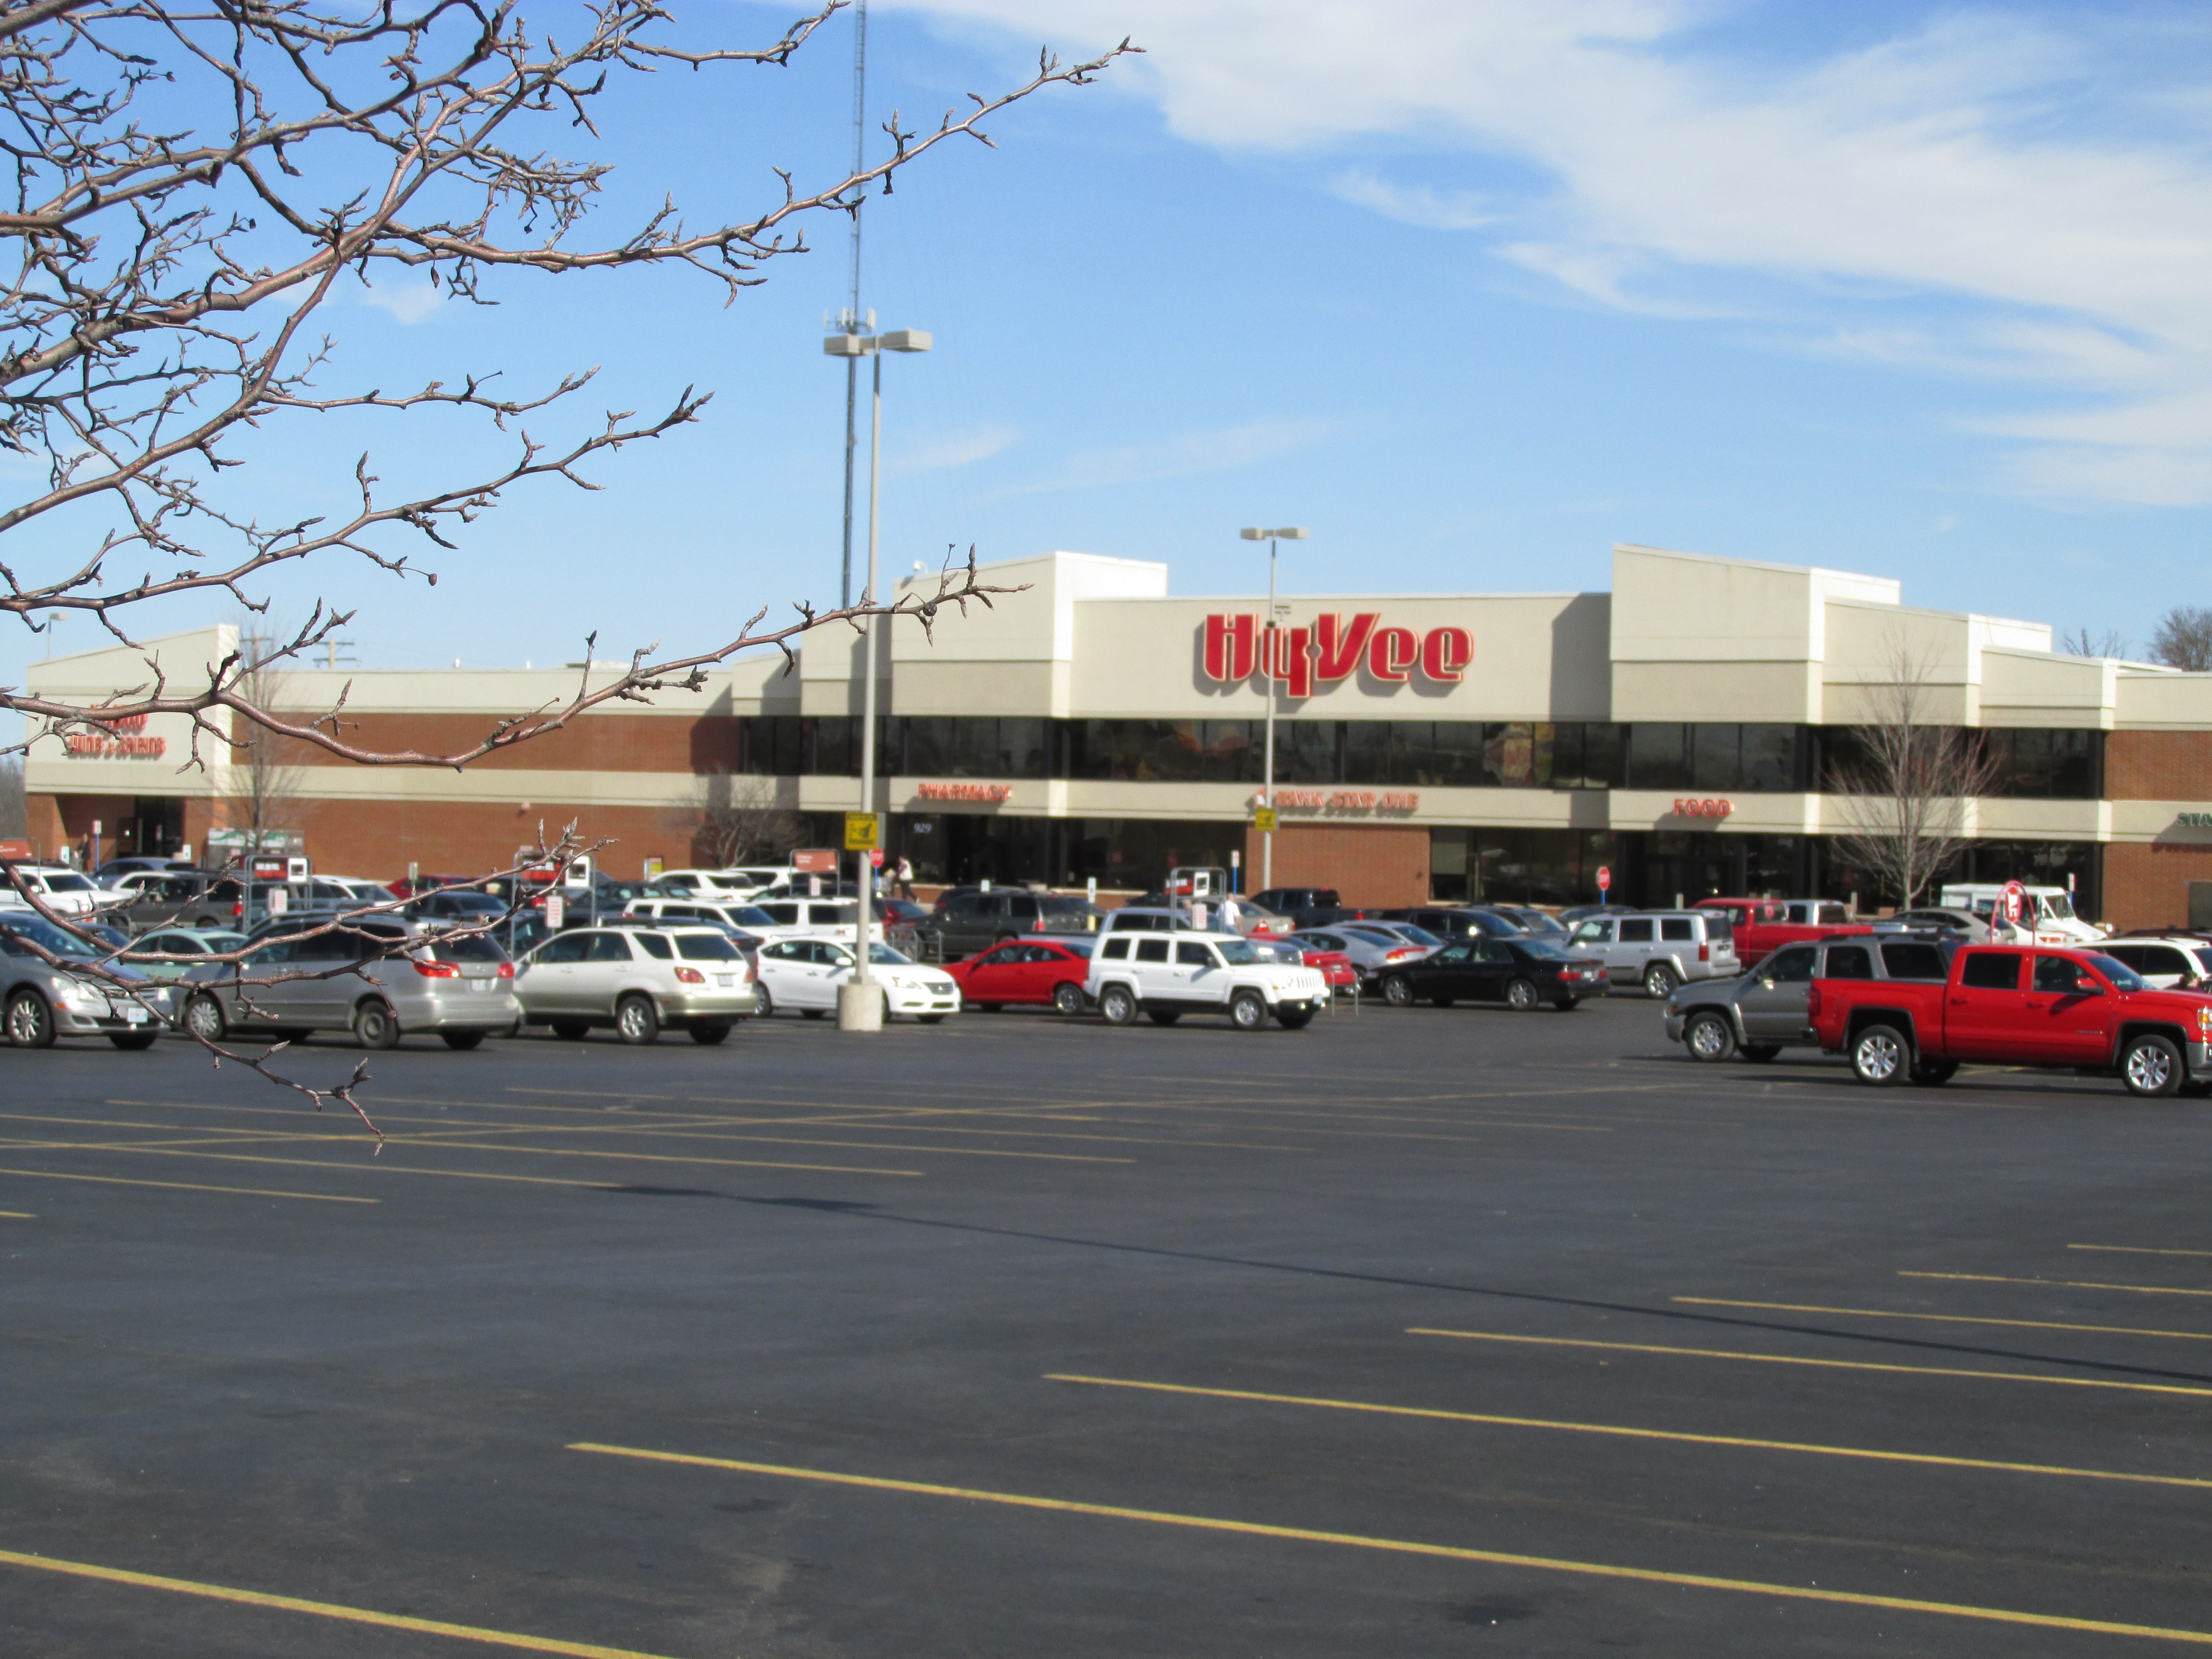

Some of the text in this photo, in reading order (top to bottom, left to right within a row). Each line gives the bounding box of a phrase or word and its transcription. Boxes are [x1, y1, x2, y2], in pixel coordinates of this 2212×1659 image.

[918, 783, 1011, 801] PHARMACY
[1276, 791, 1419, 809] BANK STAR ONE
[1673, 798, 1733, 816] FOOD
